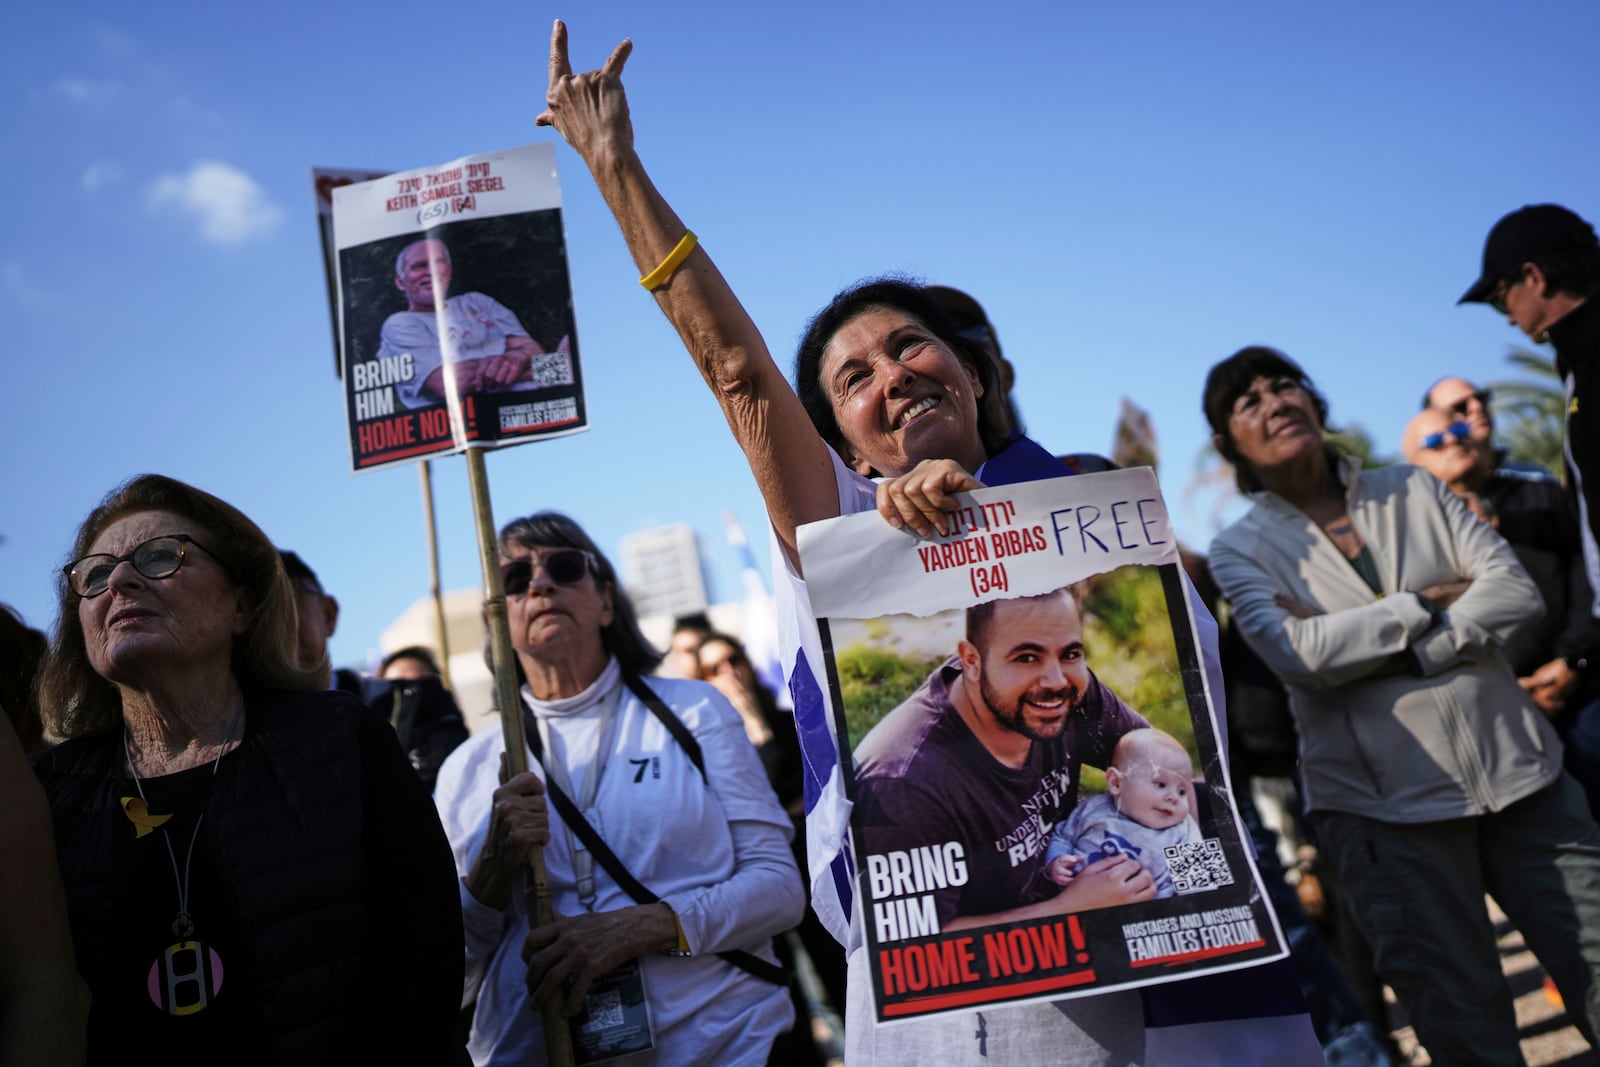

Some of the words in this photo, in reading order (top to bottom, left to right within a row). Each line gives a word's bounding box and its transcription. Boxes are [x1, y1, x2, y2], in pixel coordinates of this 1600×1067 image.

[386, 195, 418, 212] KEITH
[421, 183, 464, 204] SAMUEL
[467, 177, 505, 193] SIEGEL
[416, 202, 448, 225] (65)
[353, 352, 414, 392] BRING
[355, 386, 395, 421] HIM
[543, 405, 578, 424] FORUM
[358, 415, 416, 454] HOME
[939, 506, 979, 536] ביב
[979, 500, 1016, 532] ירדן
[1051, 498, 1167, 556] FREE
[917, 535, 989, 573] YARDEN
[991, 525, 1047, 559] BIBAS
[970, 562, 1008, 598] (34)
[629, 757, 650, 784] 7
[867, 841, 969, 900] BRING
[873, 895, 940, 943] HIM
[1122, 917, 1179, 939] HOSTAGES
[1179, 913, 1203, 929] AND
[1202, 905, 1253, 926] MISSING
[879, 937, 980, 996] HOME
[983, 914, 1089, 978] NOW!
[1126, 930, 1200, 962] FAMILIES
[1200, 919, 1260, 949] FORUM
